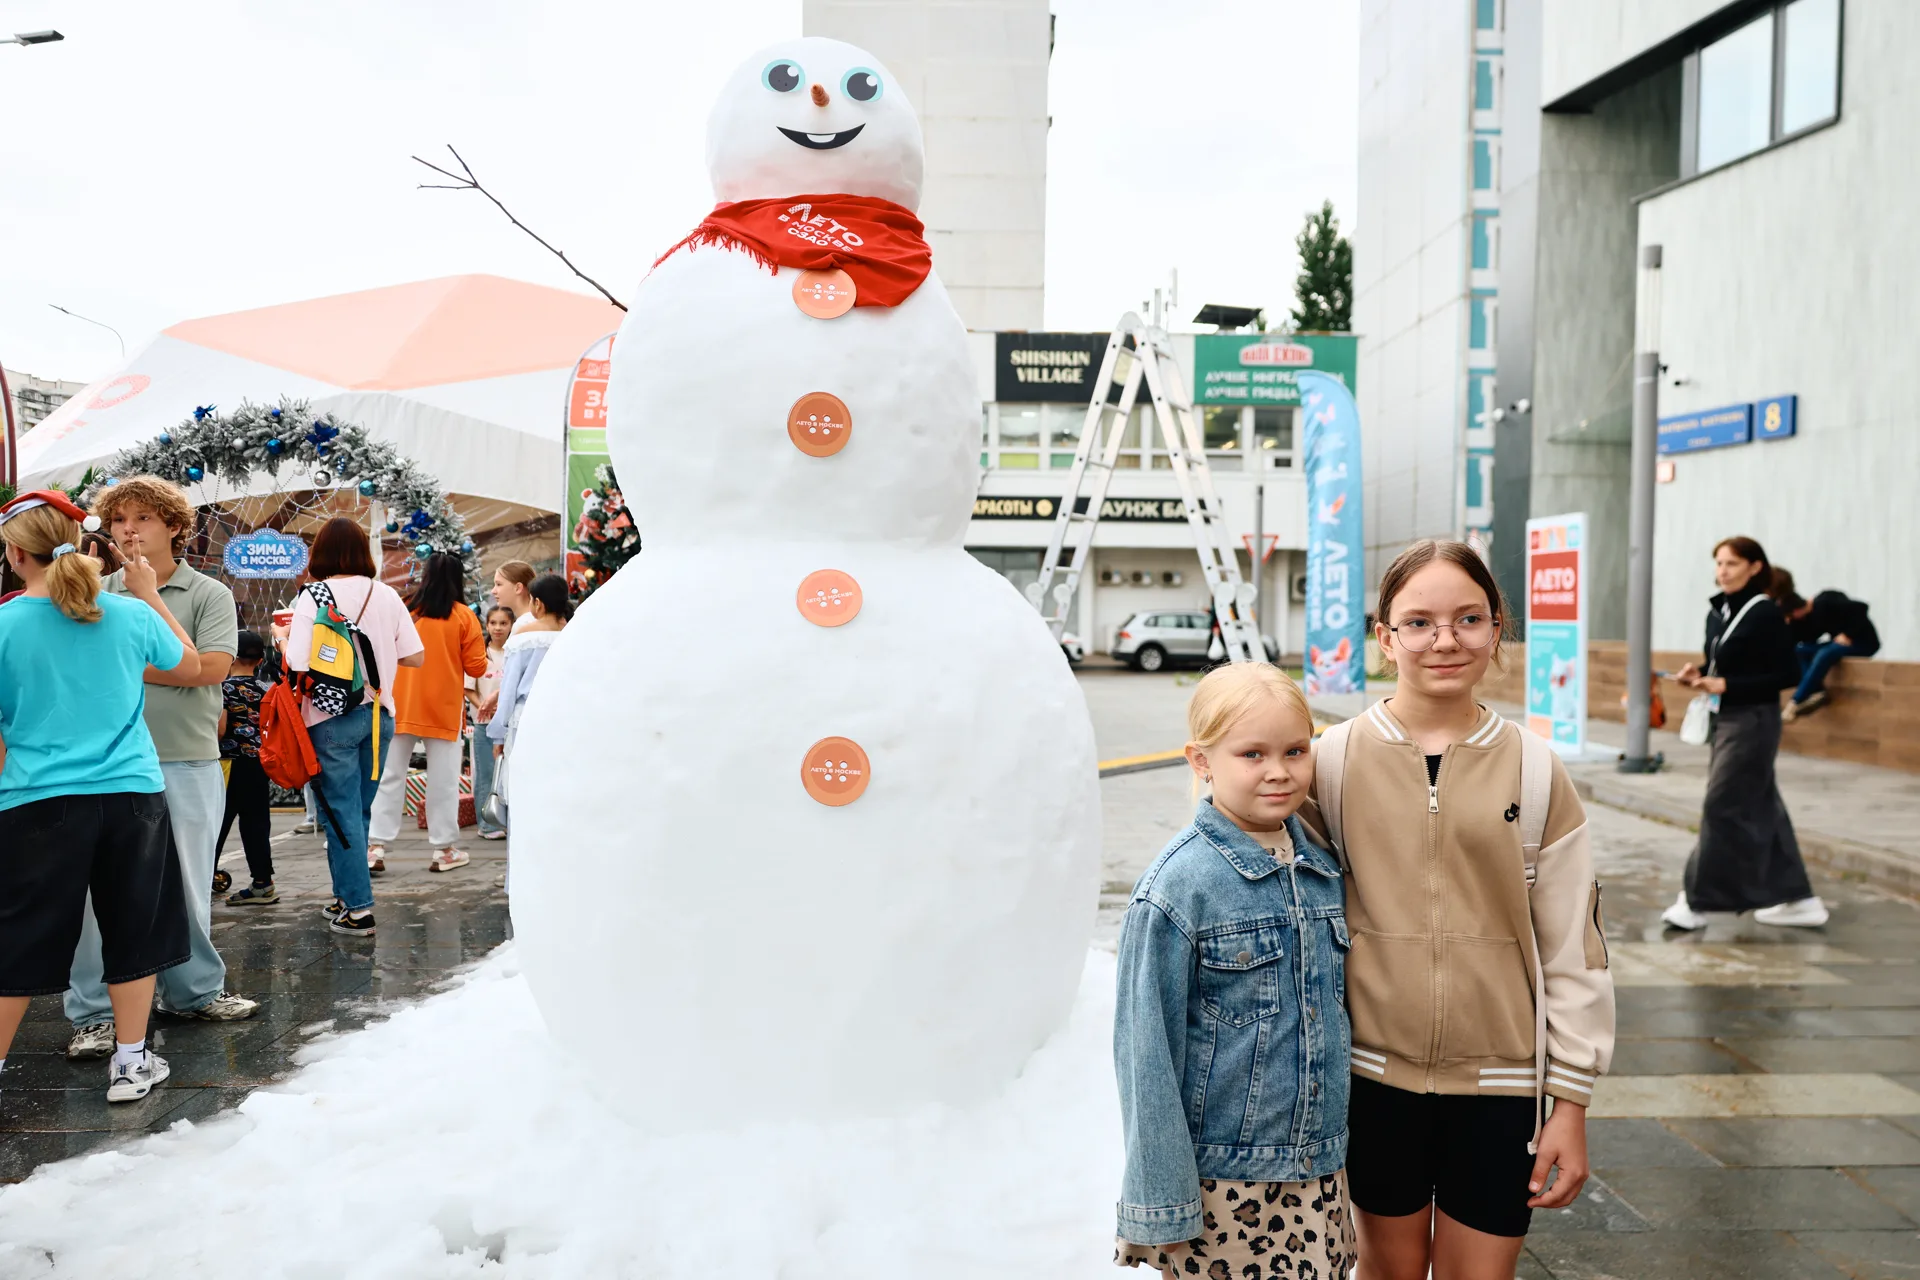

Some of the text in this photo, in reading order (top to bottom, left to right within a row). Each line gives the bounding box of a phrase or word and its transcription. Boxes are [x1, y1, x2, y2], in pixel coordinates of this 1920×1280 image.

[778, 214, 854, 252] В МОСКВЕ
[788, 203, 864, 247] ЛЕТО
[787, 227, 829, 246] СЗАО
[1010, 349, 1091, 367] SHISHKIN
[1016, 367, 1084, 384] VILLAGE
[1764, 402, 1781, 432] 8
[1099, 500, 1160, 518] АУНЖ
[1162, 500, 1188, 518] БА
[246, 543, 287, 556] ЗИМА
[240, 556, 292, 565] В МОСКВЕ
[1324, 540, 1349, 629] ЛЕТО
[1532, 567, 1576, 591] ЛЕТО
[827, 591, 853, 600] МОСКВЕ
[834, 768, 862, 776] МОСКВЕ
